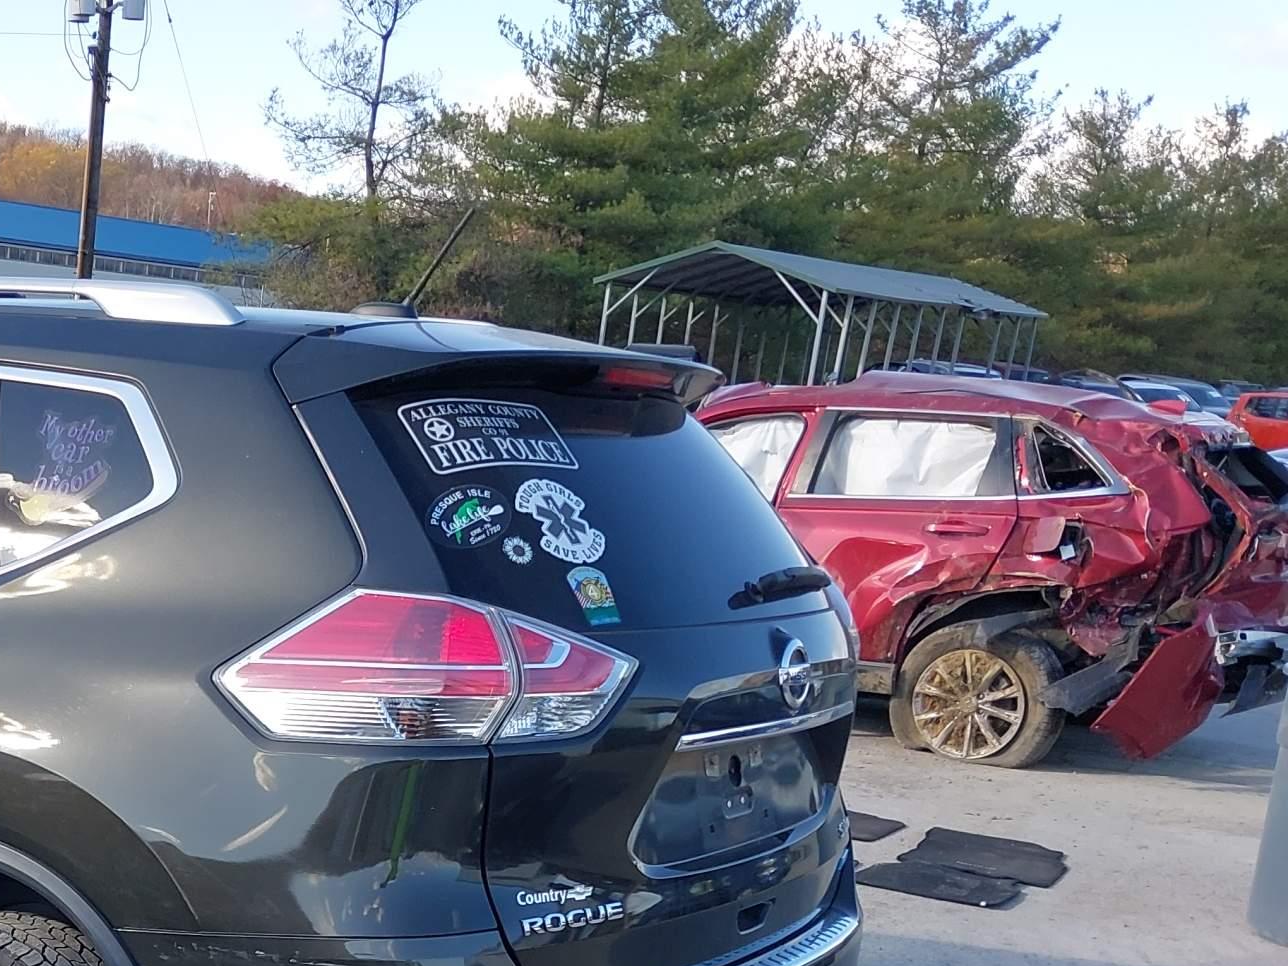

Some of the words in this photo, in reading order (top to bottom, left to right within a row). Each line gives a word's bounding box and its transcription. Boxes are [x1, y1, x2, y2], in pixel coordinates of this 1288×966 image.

[410, 403, 485, 422] ALLEGANY
[488, 404, 540, 420] COUNTY
[40, 413, 63, 450] My
[68, 418, 114, 444] other
[51, 442, 90, 464] car
[430, 437, 495, 468] FIRE
[492, 437, 570, 464] POLICE
[33, 459, 103, 497] broom
[430, 490, 464, 526] PRESQUE
[466, 488, 491, 499] ISLE
[518, 481, 544, 510] TOUGH
[545, 482, 584, 508] GIRLS
[543, 539, 579, 561] SAVE
[582, 531, 603, 560] LIVES
[516, 888, 567, 906] Country
[521, 902, 624, 937] ROGUE
